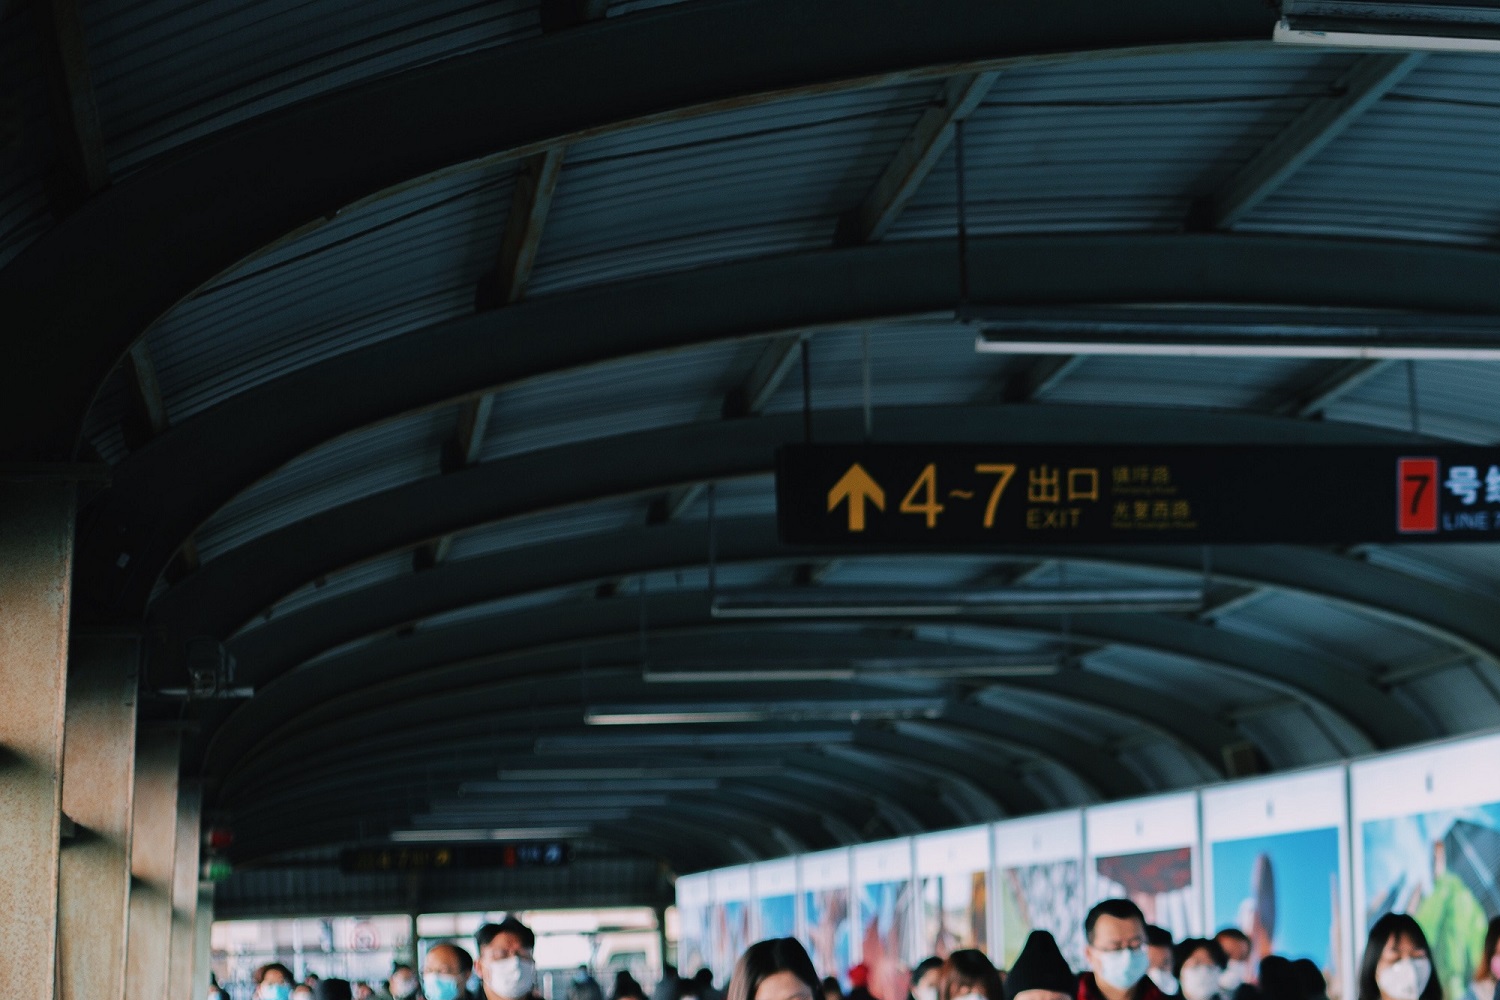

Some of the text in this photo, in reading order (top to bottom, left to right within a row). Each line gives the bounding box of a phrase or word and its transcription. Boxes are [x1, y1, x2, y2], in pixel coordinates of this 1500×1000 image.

[1027, 465, 1100, 504] 出口
[1404, 474, 1431, 517] 7
[1026, 508, 1082, 530] EXIT
[1443, 511, 1488, 531] LINE
